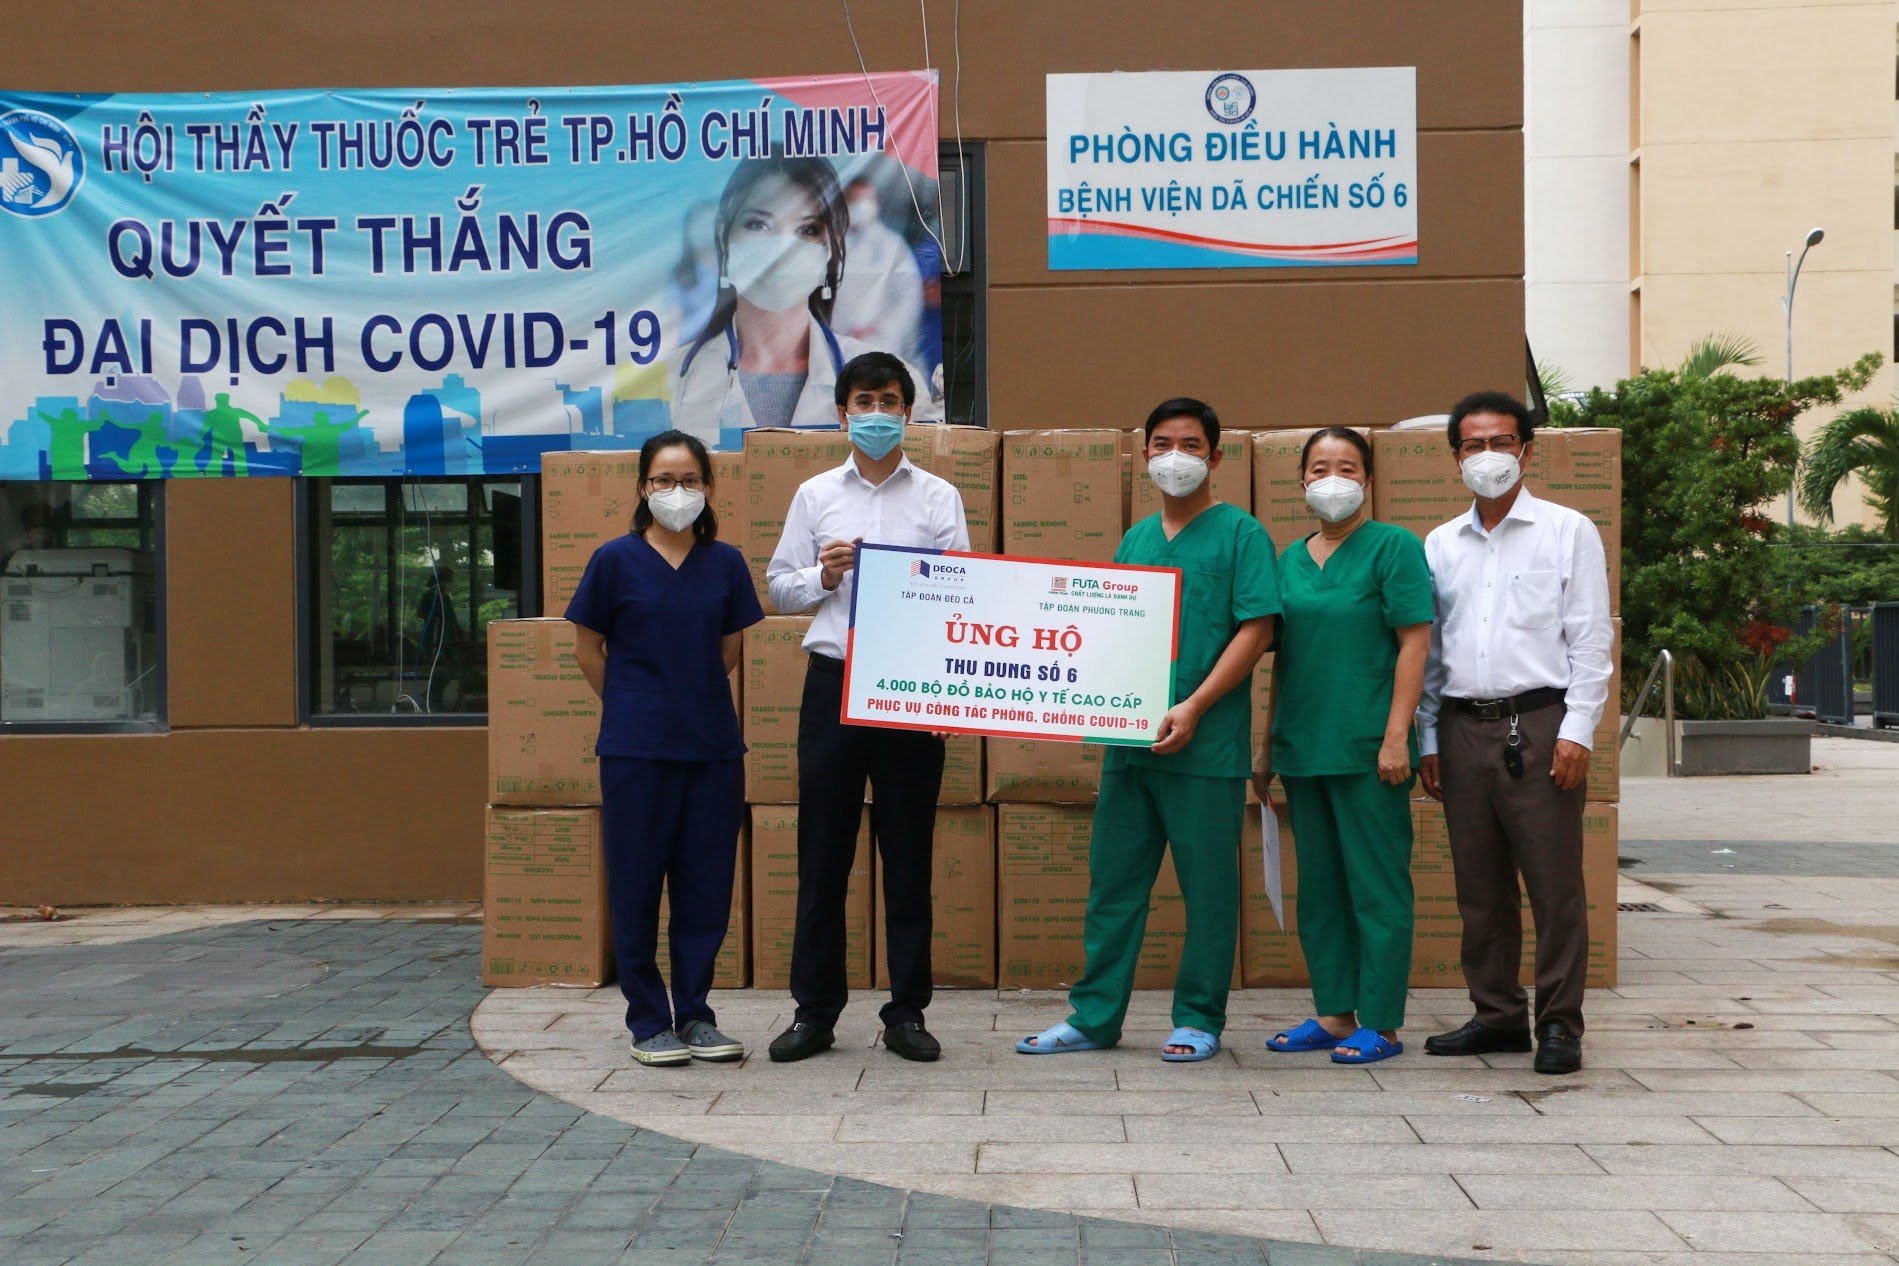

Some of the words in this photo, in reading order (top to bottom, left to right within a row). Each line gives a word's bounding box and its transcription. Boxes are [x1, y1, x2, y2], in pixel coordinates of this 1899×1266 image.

[103, 111, 173, 182] HỘI
[187, 103, 298, 171] THẦY
[311, 101, 455, 169] THUỐC
[466, 98, 549, 166] TRẺ
[563, 92, 687, 164] TP.HỒ
[701, 96, 772, 158] CHÍ
[785, 107, 887, 158] MINH
[1070, 126, 1193, 163] PHÒNG
[1205, 119, 1287, 161] ĐIỀU
[1300, 122, 1396, 160] HÀNH
[1058, 181, 1132, 218] BỆNH
[1141, 180, 1202, 216] VIỆN
[1212, 179, 1248, 210] DÃ
[1257, 173, 1343, 210] CHIẾN
[1349, 172, 1386, 208] SỐ
[1394, 183, 1408, 208] 6
[108, 191, 337, 280] QUYẾT
[357, 184, 592, 272] THẮNG
[42, 318, 153, 387] ĐẠI
[179, 316, 336, 387] DỊCH
[360, 310, 662, 376] COVID-19
[933, 564, 966, 575] DEOCA
[1072, 578, 1100, 590] FUTA
[1102, 580, 1139, 594] Group
[1118, 608, 1146, 618] TRANG
[945, 612, 1020, 649] ỦNG
[1031, 624, 1083, 658] HỘ
[944, 657, 978, 676] THU
[983, 660, 1032, 680] DUNG
[1037, 660, 1061, 682] SỐ
[1067, 667, 1078, 683] 6
[876, 678, 917, 693] 4.000
[921, 680, 943, 698] BỘ
[946, 679, 970, 697] ĐỒ
[974, 682, 1007, 700] BẢO
[1011, 686, 1034, 705] HỘ
[1039, 691, 1048, 703] Y
[1052, 688, 1070, 704] TẾ
[1071, 693, 1106, 707] CAO
[1110, 692, 1143, 709] CẤP
[867, 698, 901, 714] PHỤC
[905, 701, 922, 716] VỤ
[926, 701, 960, 717] CÔNG
[964, 704, 988, 719] TÁC
[1042, 709, 1085, 726] CHỐNG
[1089, 715, 1149, 730] COVID-19
